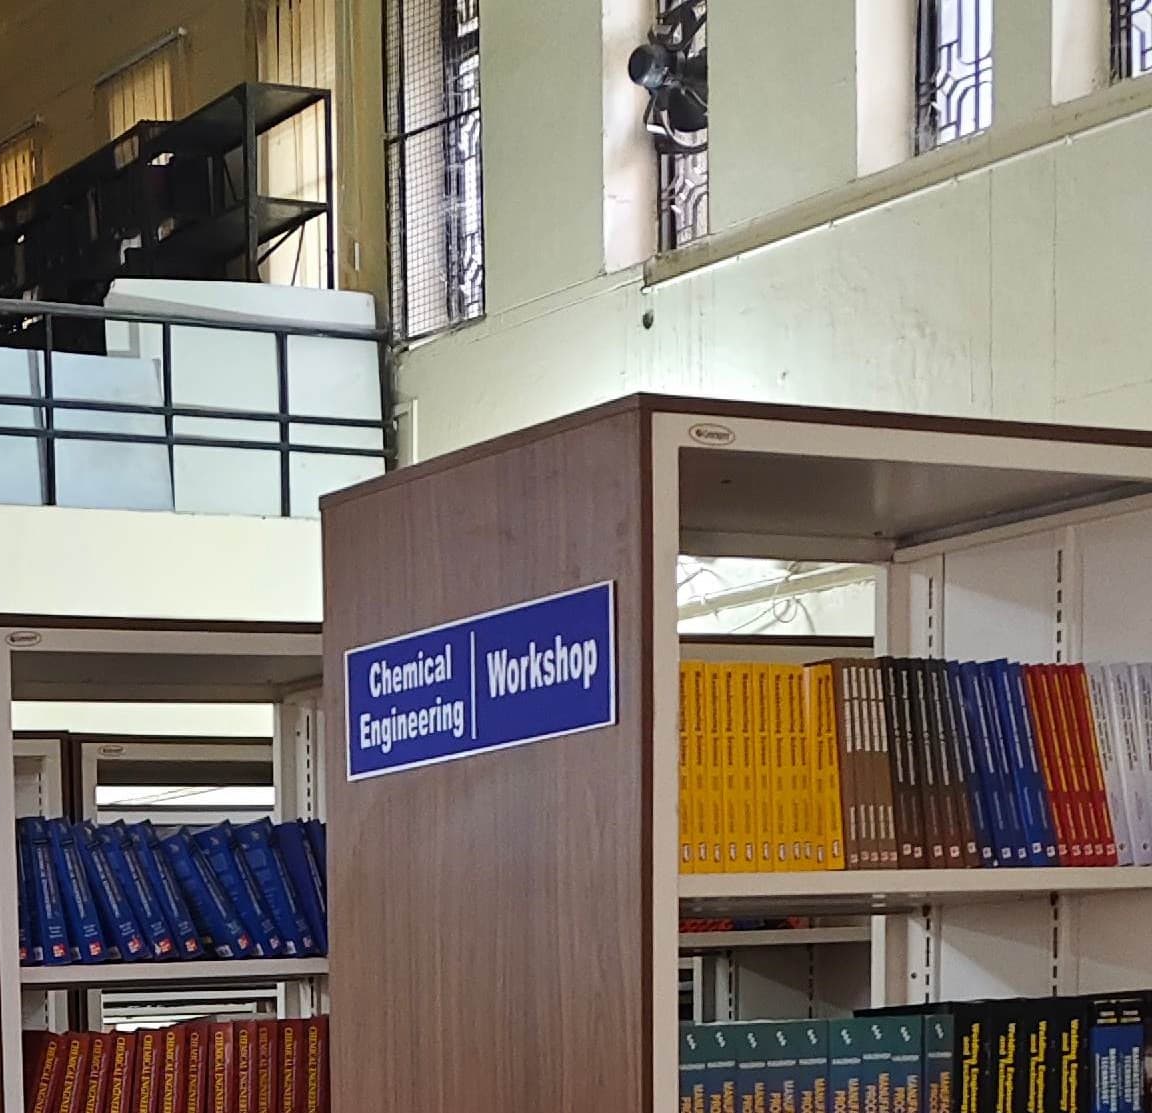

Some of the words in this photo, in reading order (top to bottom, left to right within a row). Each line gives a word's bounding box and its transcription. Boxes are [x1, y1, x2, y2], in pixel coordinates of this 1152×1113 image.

[369, 644, 452, 698] Chemical
[486, 634, 598, 698] Workshop
[360, 697, 464, 753] Engineering
